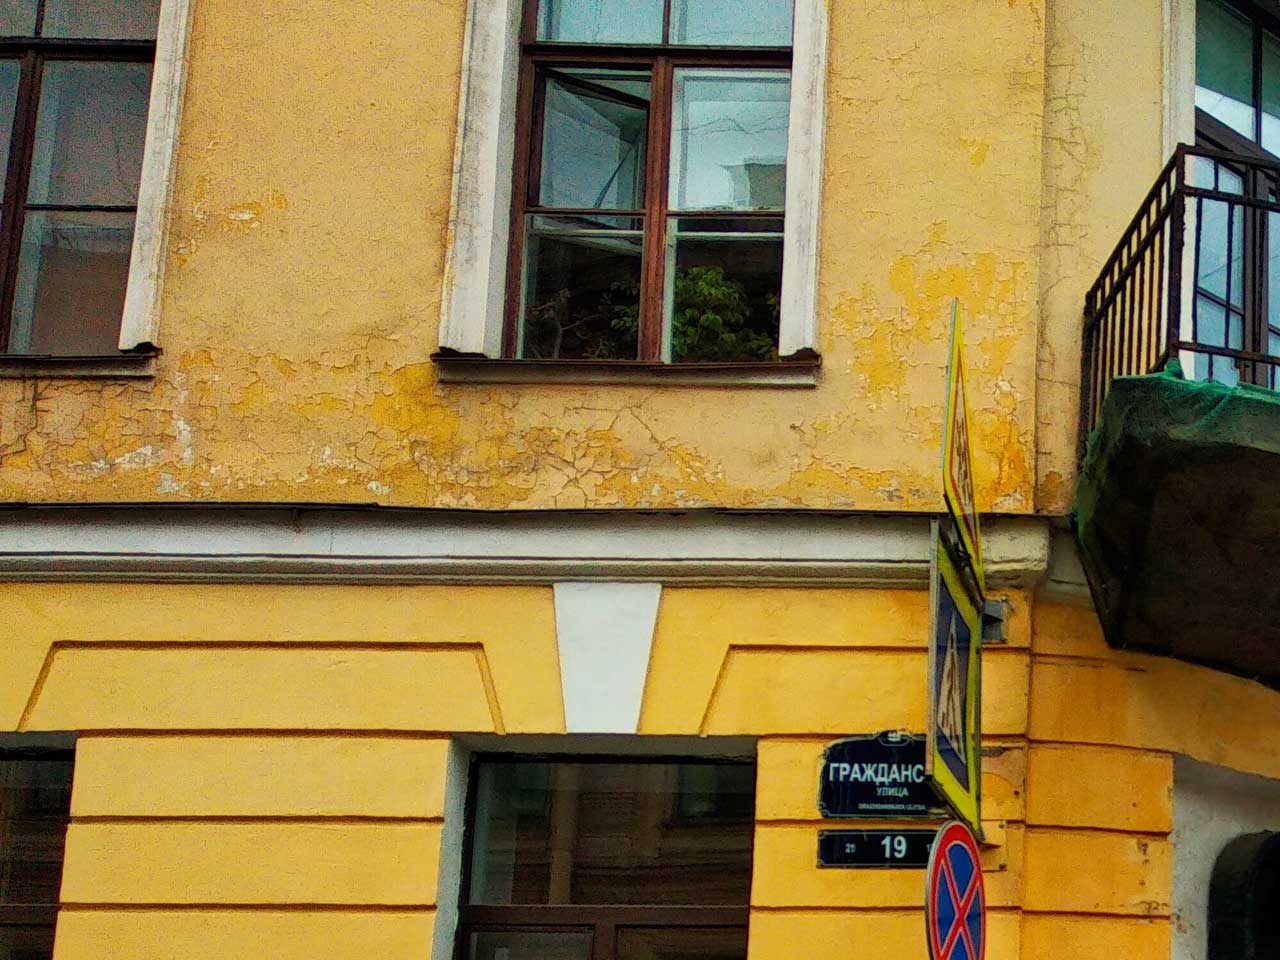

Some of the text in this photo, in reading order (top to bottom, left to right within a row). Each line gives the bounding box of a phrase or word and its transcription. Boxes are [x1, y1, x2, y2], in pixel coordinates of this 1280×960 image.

[829, 763, 925, 785] ГРАЖДАНС
[876, 787, 909, 798] УЛИЦА
[881, 836, 907, 858] 19
